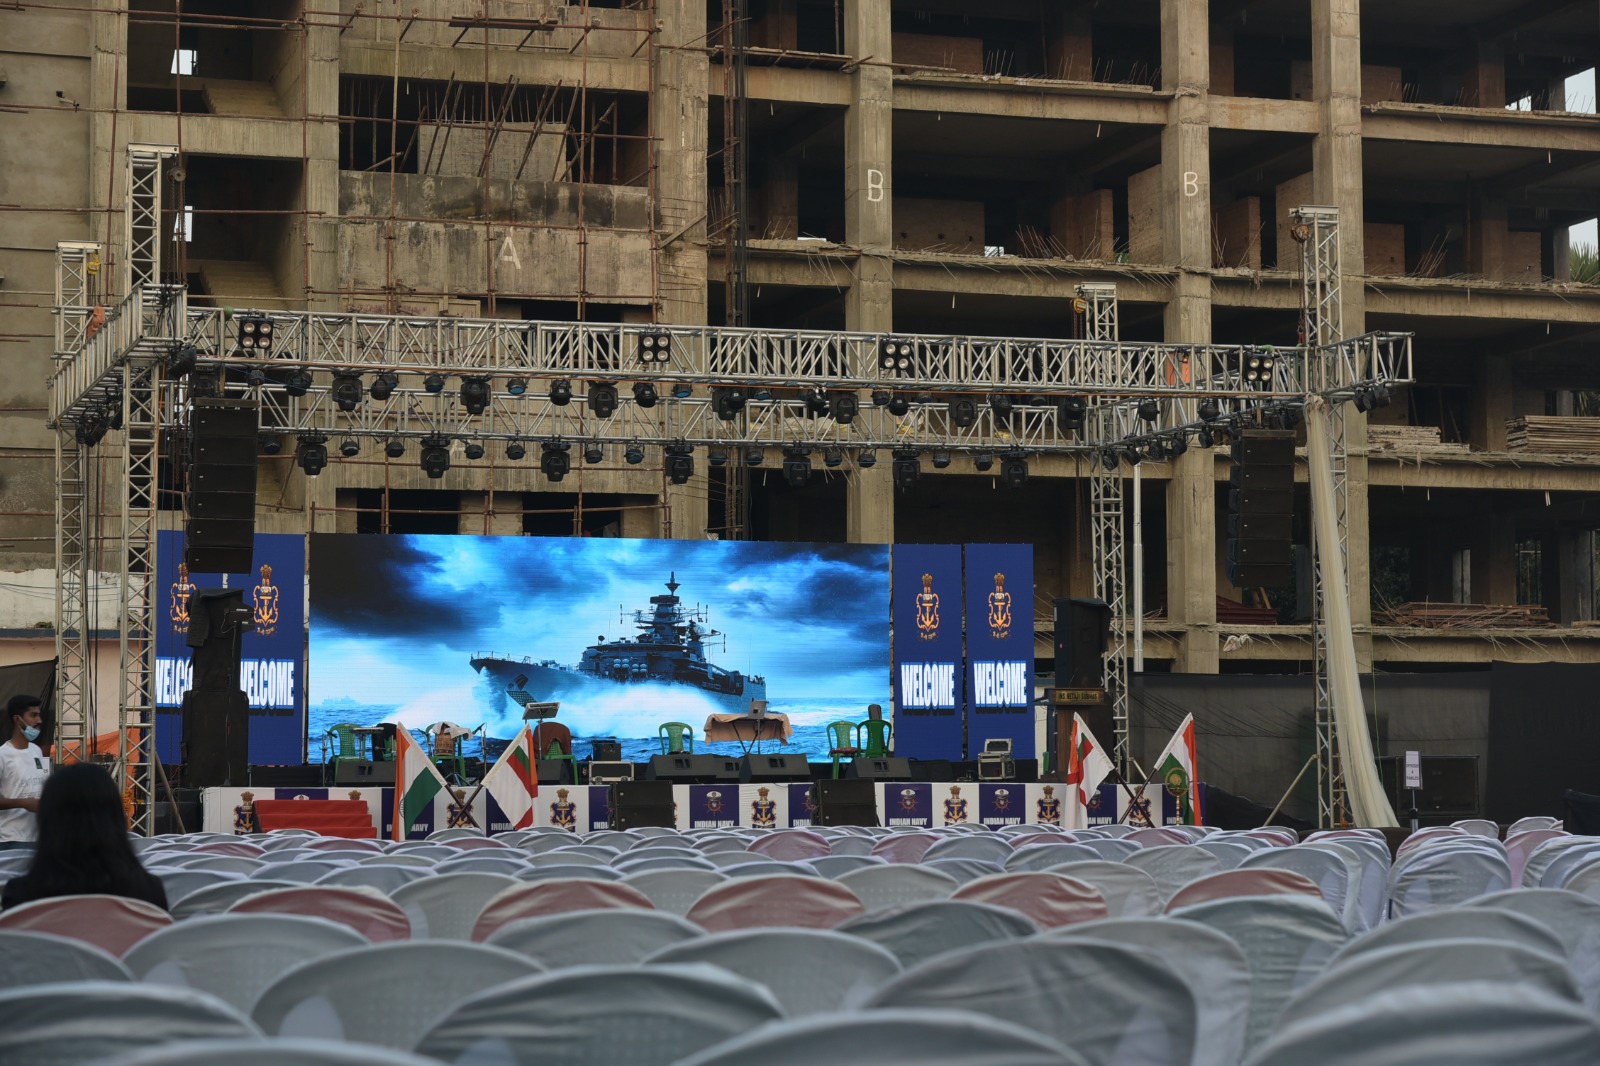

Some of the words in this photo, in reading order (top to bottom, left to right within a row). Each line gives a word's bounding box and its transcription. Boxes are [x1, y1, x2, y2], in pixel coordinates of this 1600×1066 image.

[867, 168, 884, 202] B
[1183, 171, 1199, 197] B
[495, 236, 522, 270] A
[901, 663, 955, 707] WELCOME
[974, 661, 1027, 705] WELCOME
[593, 821, 609, 830] INDI
[694, 820, 717, 829] INDIAN
[717, 819, 735, 828] NAVY
[889, 817, 911, 827] INDIAN
[911, 817, 928, 827] NAVY
[983, 817, 1004, 826] INDIAN
[1005, 817, 1021, 826] NAVY
[1096, 816, 1113, 825] NAVY
